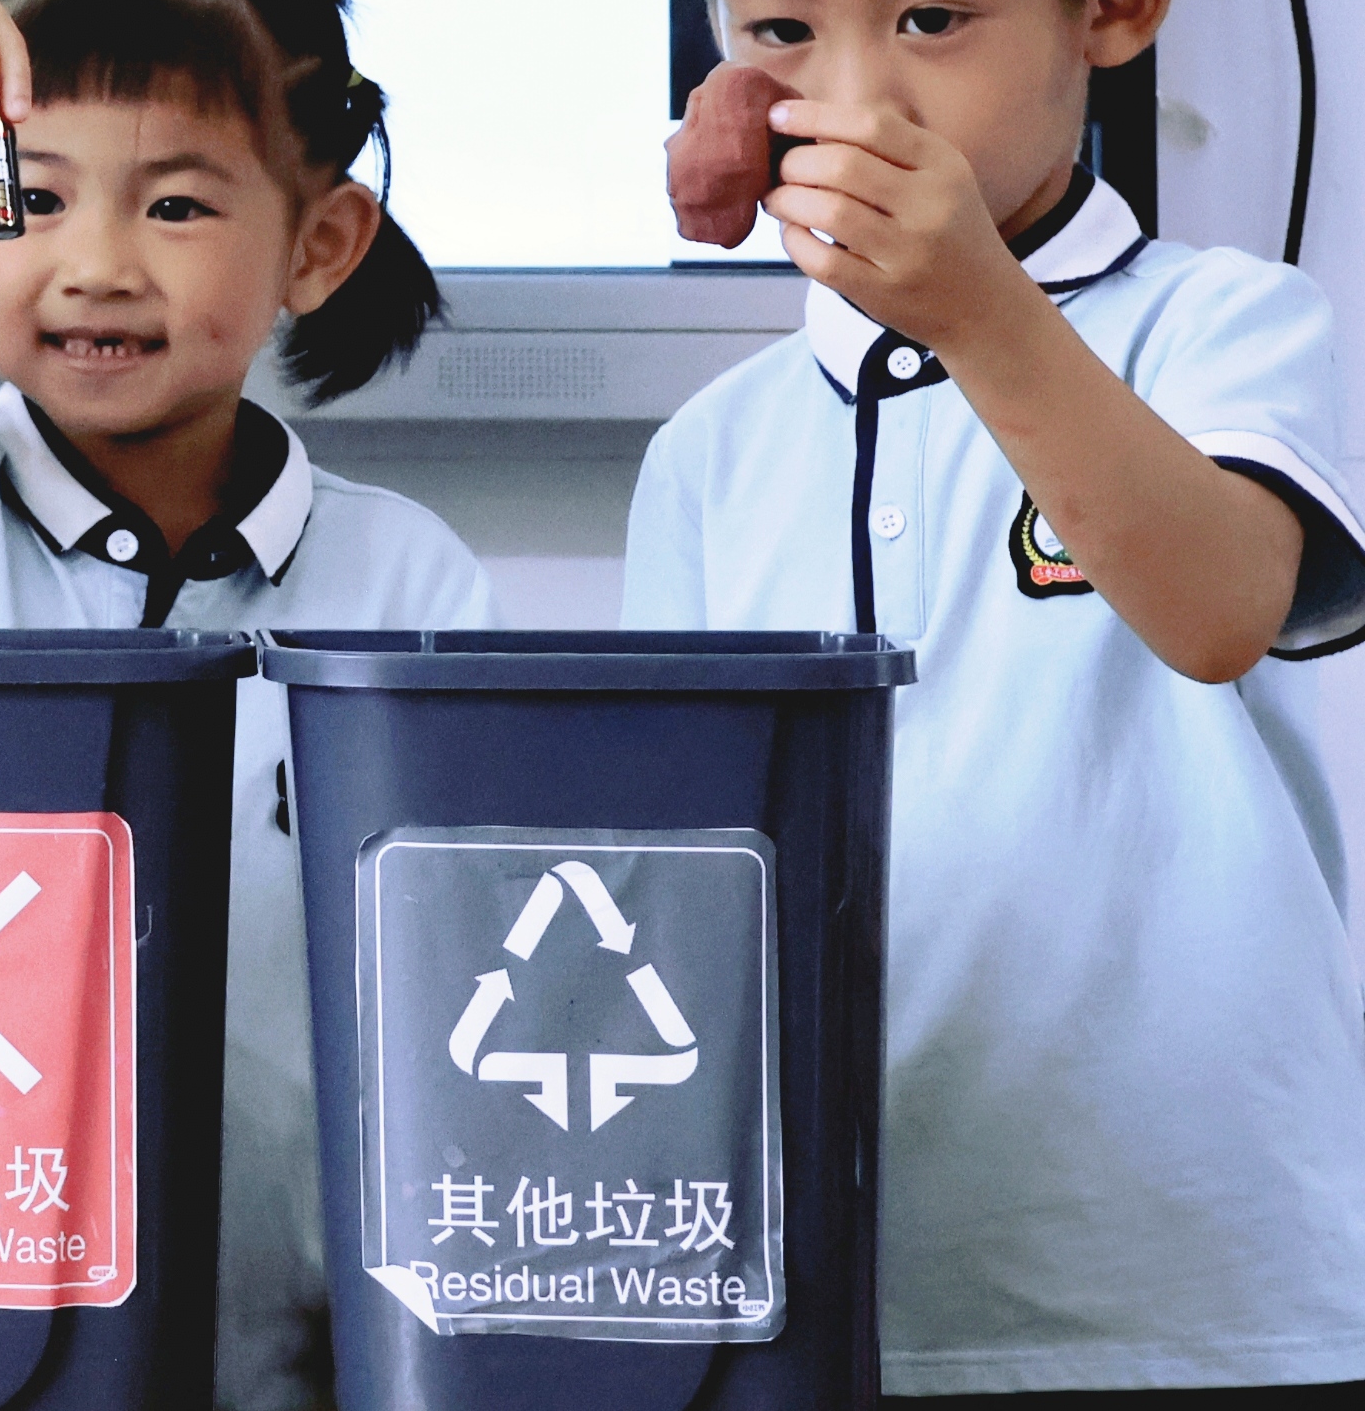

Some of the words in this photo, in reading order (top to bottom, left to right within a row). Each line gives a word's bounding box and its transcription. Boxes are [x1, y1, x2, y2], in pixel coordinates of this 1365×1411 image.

[427, 1173, 736, 1252] 其他垃圾
[409, 1259, 595, 1304] Residual
[610, 1266, 747, 1307] Waste
